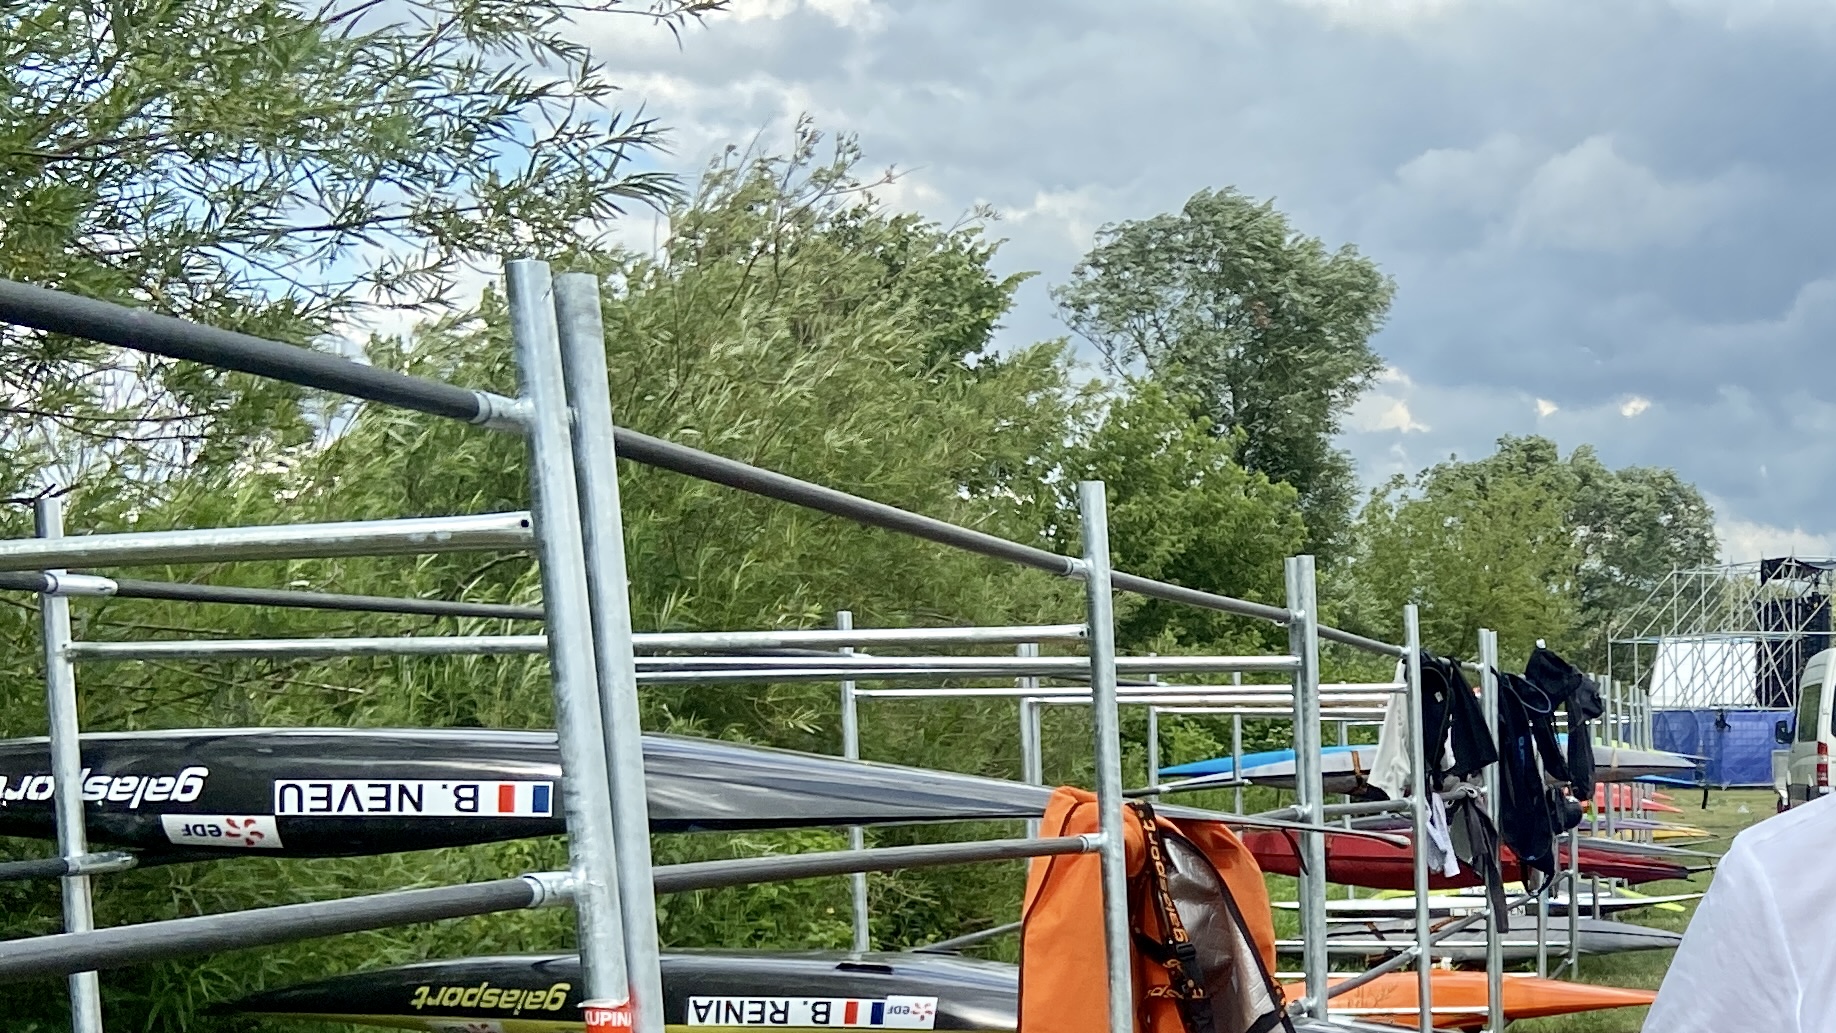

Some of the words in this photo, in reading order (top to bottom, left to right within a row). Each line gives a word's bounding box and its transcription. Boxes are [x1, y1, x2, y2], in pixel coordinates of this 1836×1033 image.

[279, 783, 424, 813] NEVEU
[441, 783, 483, 813] B.
[410, 981, 572, 1015] galasport
[692, 999, 790, 1025] RENIA
[803, 1000, 832, 1025] B.
